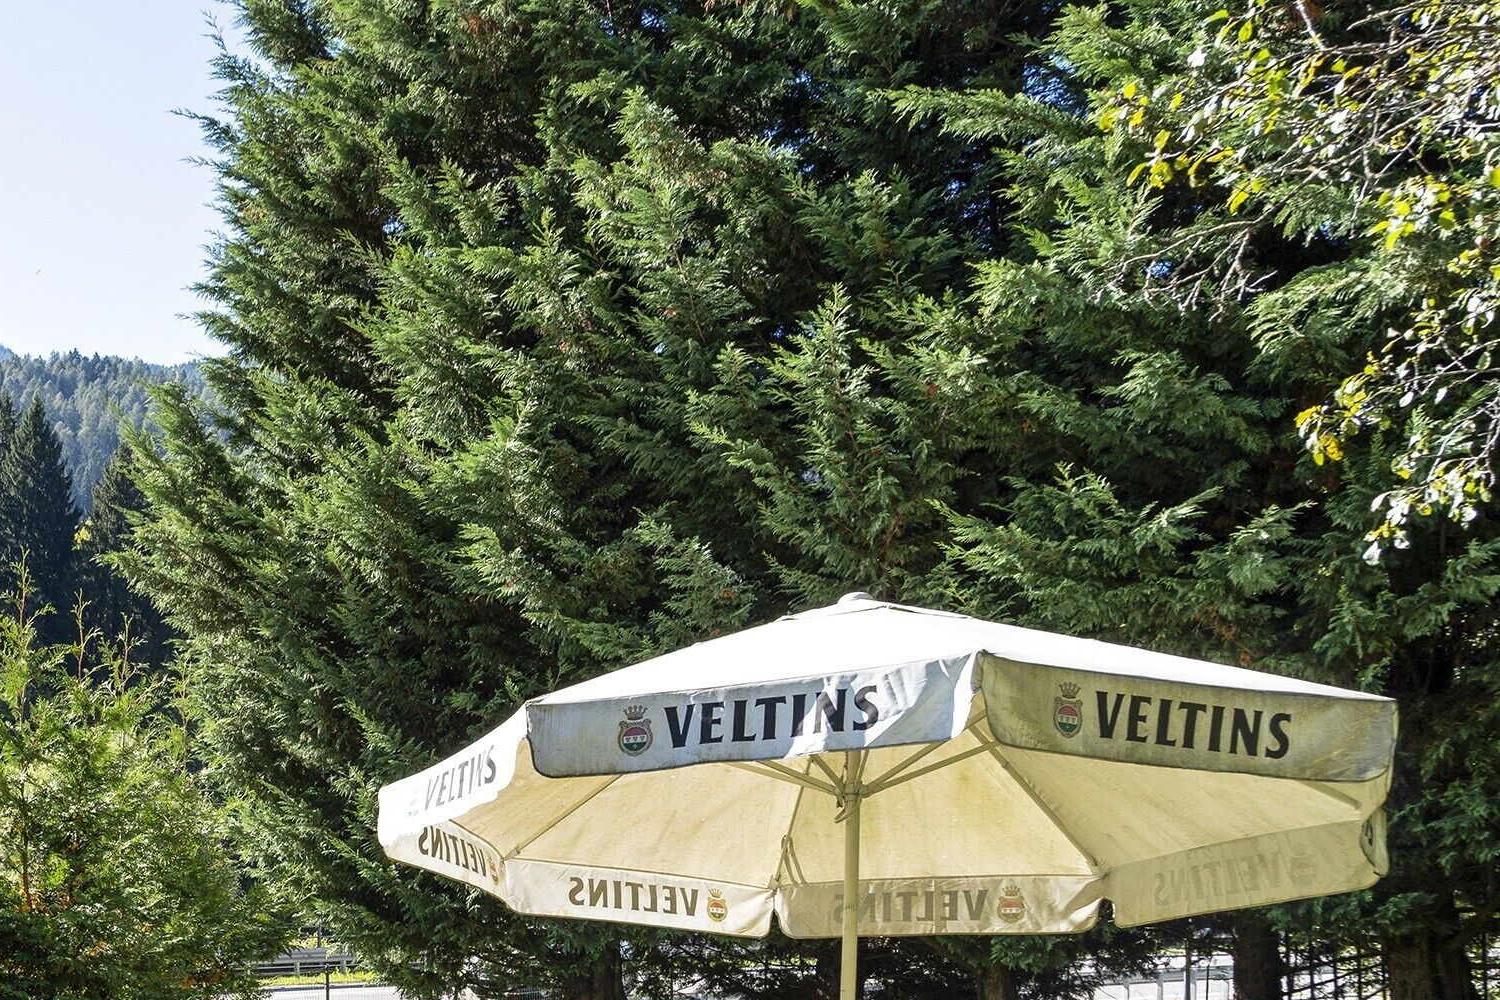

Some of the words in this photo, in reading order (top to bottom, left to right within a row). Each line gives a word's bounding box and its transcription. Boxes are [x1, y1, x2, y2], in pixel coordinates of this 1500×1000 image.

[663, 684, 879, 749] VELTINS
[1095, 690, 1292, 760] VELTINS
[424, 744, 497, 811] VELTINS
